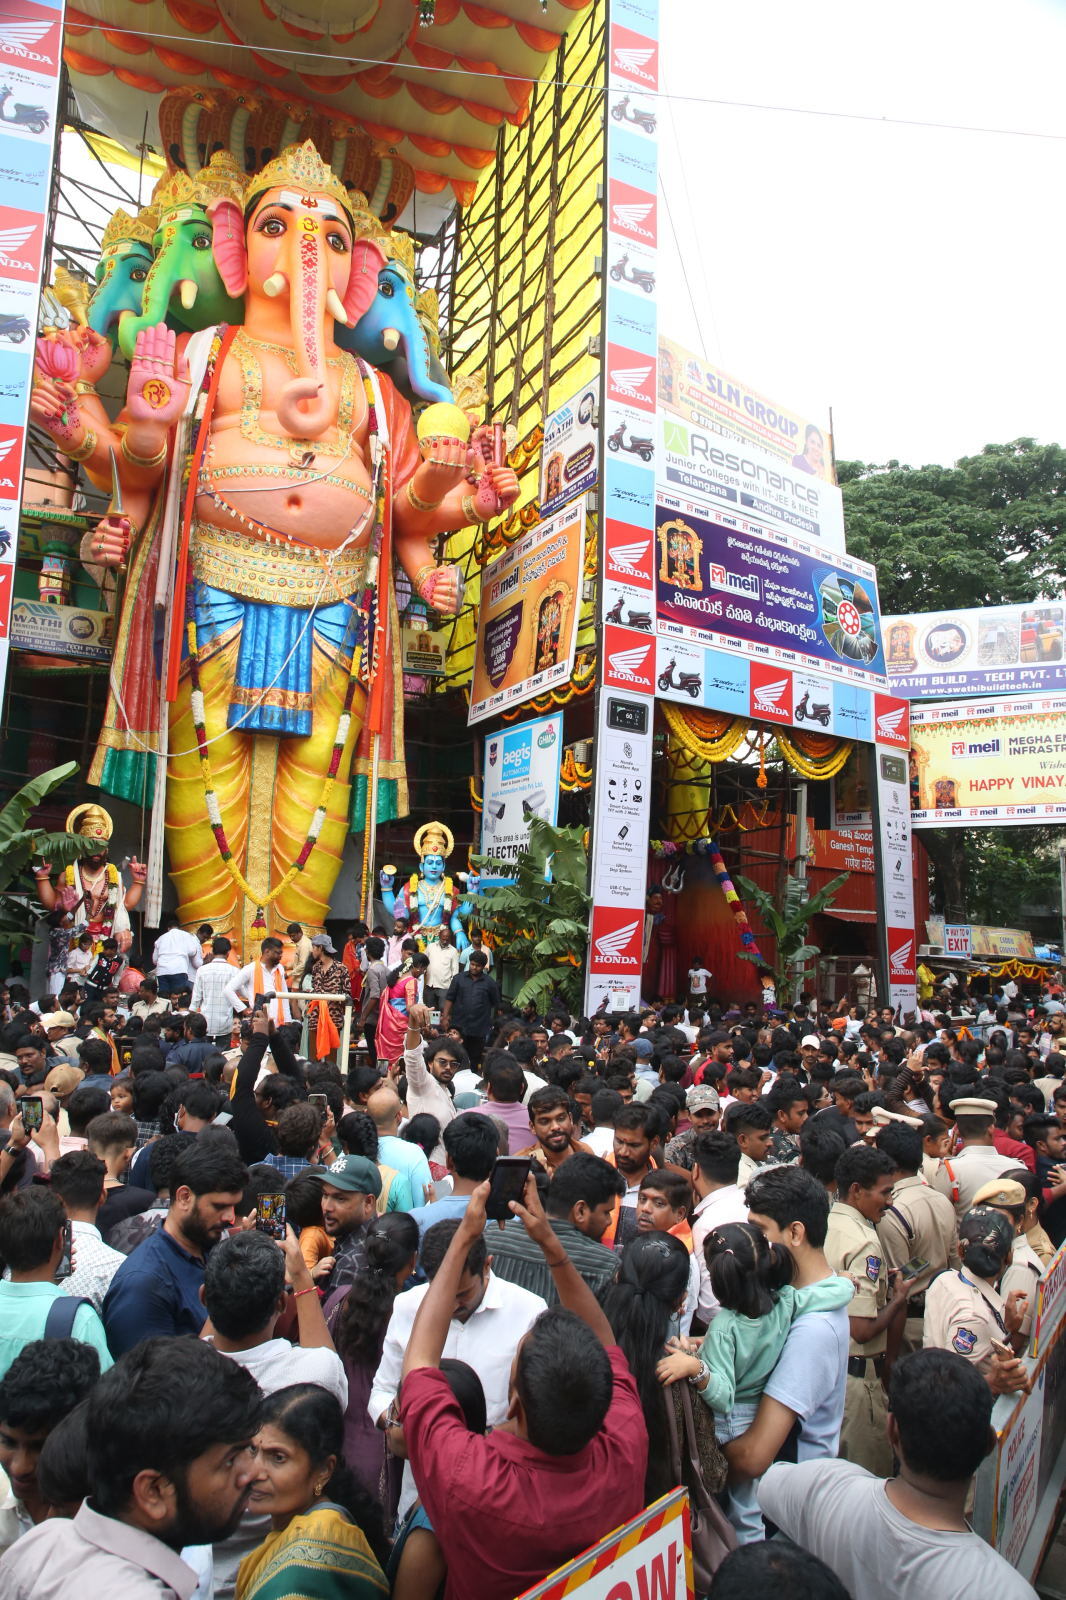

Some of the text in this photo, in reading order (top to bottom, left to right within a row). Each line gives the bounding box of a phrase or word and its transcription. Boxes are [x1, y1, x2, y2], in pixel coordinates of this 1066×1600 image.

[614, 60, 656, 83] HONDA
[612, 218, 655, 239] HONDA
[610, 384, 653, 404] HONDA
[706, 372, 740, 408] SLN
[744, 395, 798, 438] GROUP
[690, 434, 819, 506] Resonance
[666, 453, 696, 471] Junior
[699, 462, 740, 487] Colleges
[742, 473, 760, 494] with
[762, 485, 788, 509] IIT-JEE
[798, 501, 819, 518] NEET
[678, 471, 727, 498] Telangana
[752, 499, 814, 532] Andhra Pradesh
[608, 562, 650, 580] HONDA
[500, 566, 519, 594] meil
[729, 574, 758, 593] meil
[674, 592, 817, 642] వినాయక చవితి శుభాకాంక్షలు
[608, 670, 650, 686] HONDA
[932, 675, 967, 686] BUILD
[984, 672, 1014, 682] TECH
[1020, 670, 1050, 680] PVT.
[754, 703, 789, 716] HONDA
[941, 710, 958, 718] meil
[539, 732, 556, 746] GHMC
[878, 730, 906, 741] HONDA
[1008, 735, 1052, 746] MEGHA
[503, 742, 531, 766] aegis
[968, 739, 1000, 754] meil
[503, 766, 530, 778] AUTOMATION
[969, 778, 1014, 792] HAPPY
[1017, 806, 1036, 814] meil
[830, 840, 854, 852] Ganesh
[948, 938, 968, 951] EXIT
[594, 956, 638, 965] HONDA
[1007, 1416, 1025, 1470] POLICE
